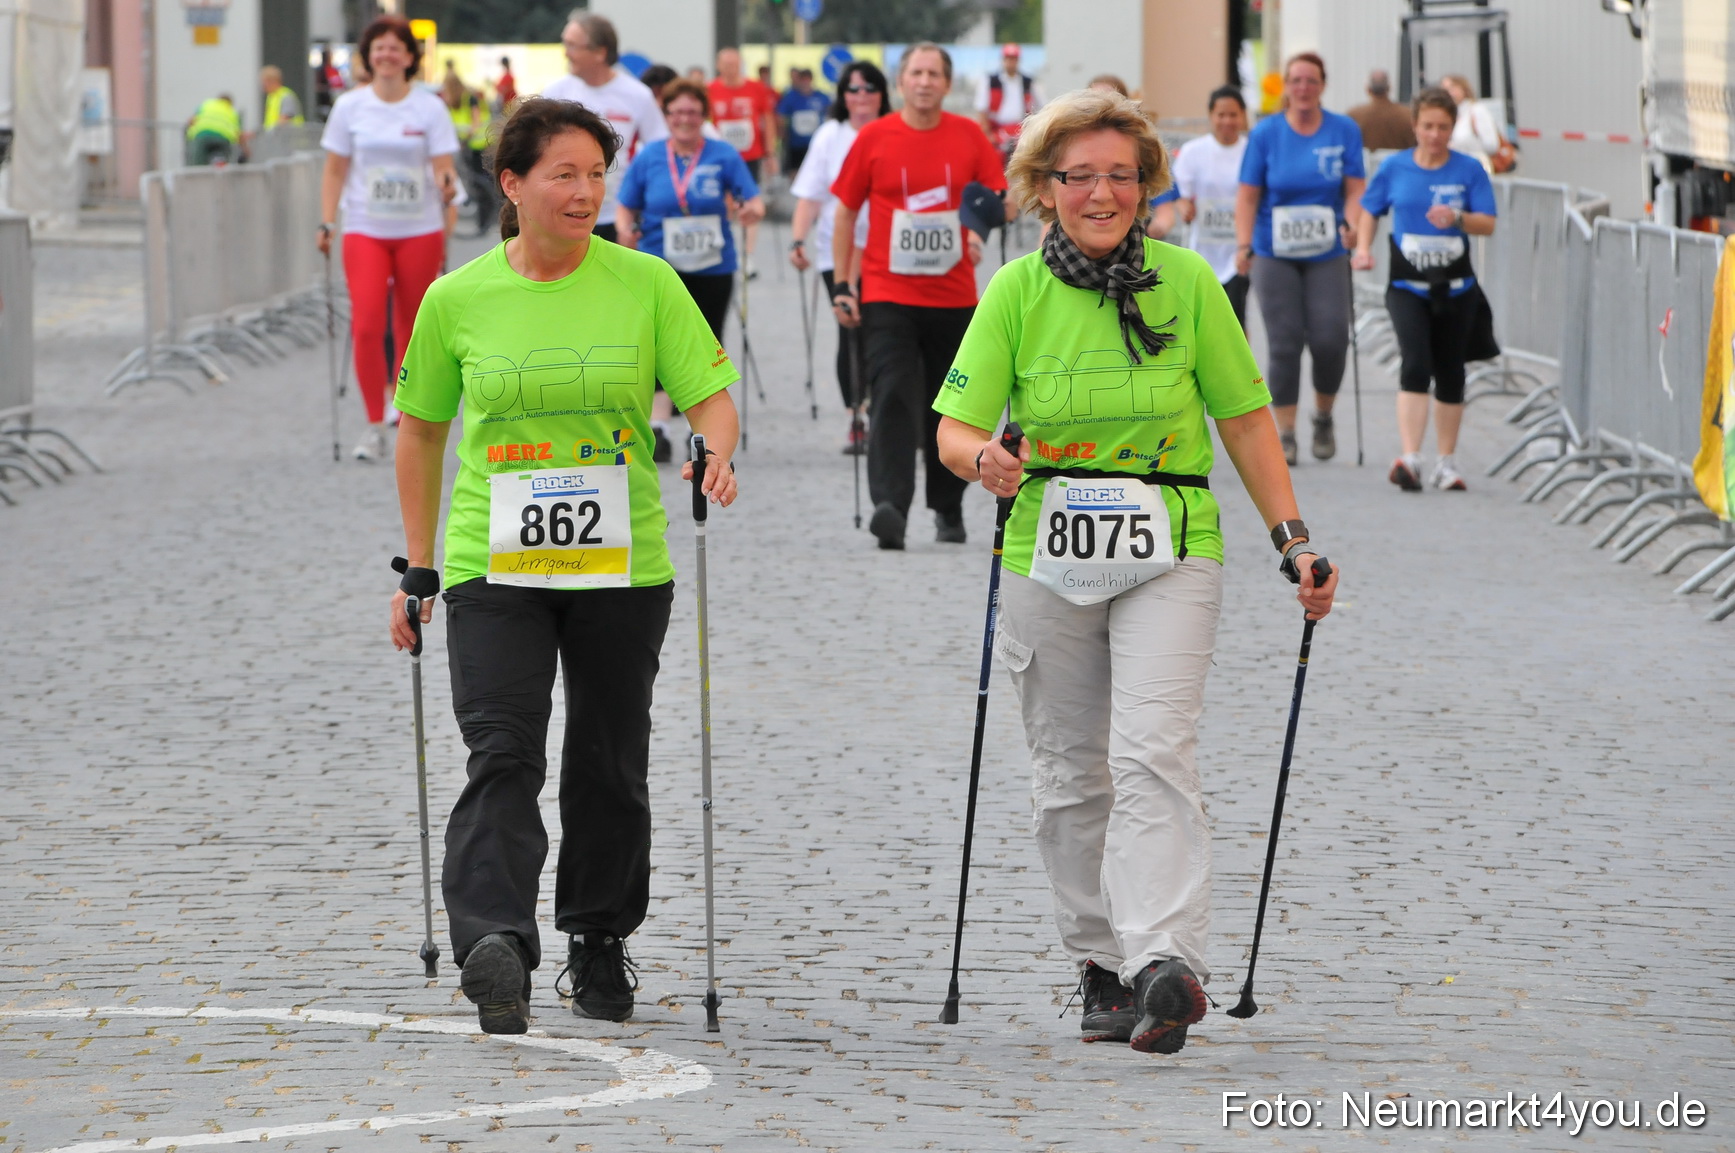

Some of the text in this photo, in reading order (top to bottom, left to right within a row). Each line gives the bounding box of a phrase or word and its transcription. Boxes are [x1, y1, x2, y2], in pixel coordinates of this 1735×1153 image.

[901, 229, 953, 251] 8003
[1280, 218, 1327, 240] 8024
[471, 345, 639, 416] OPF
[1024, 346, 1187, 419] OPF
[525, 407, 616, 420] Automatisierungstechnik
[1056, 419, 1071, 427] und
[1072, 413, 1166, 425] Automatisierungstechnik
[487, 442, 553, 463] MERZ
[1036, 439, 1097, 462] MERZ
[532, 475, 585, 491] BOCK
[1066, 488, 1125, 502] BOCK
[520, 500, 603, 547] 862
[1047, 511, 1155, 560] 8075
